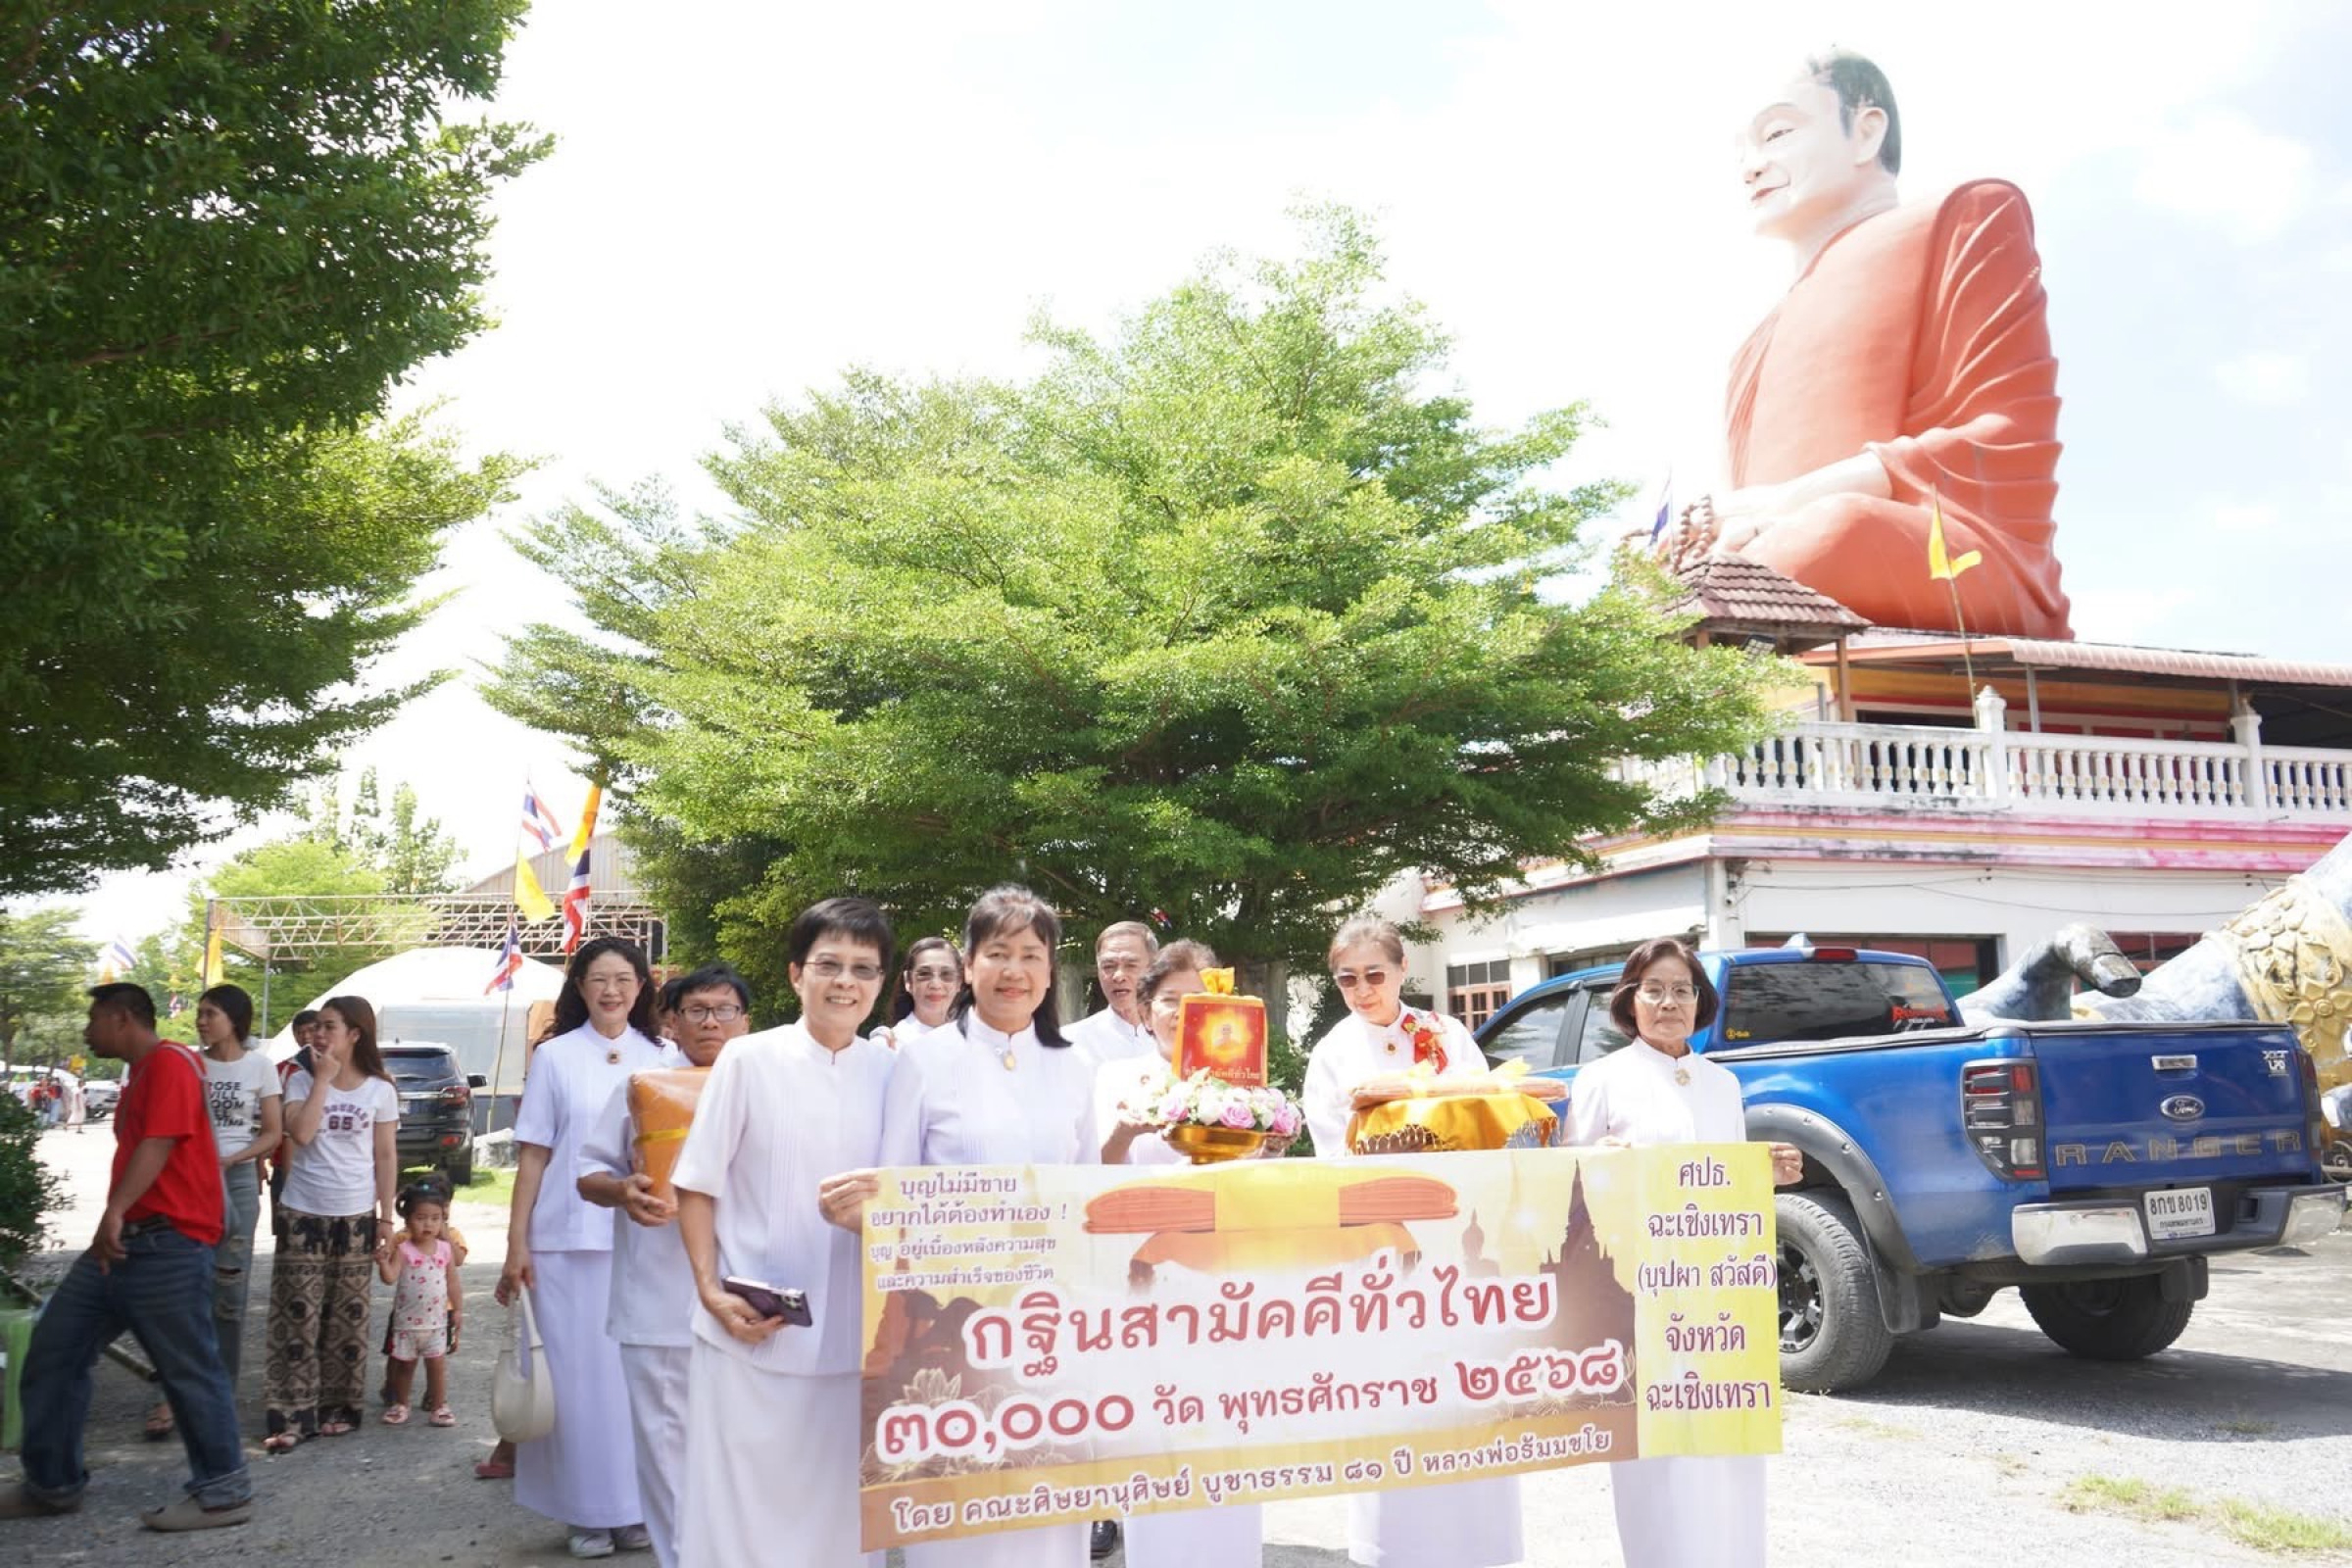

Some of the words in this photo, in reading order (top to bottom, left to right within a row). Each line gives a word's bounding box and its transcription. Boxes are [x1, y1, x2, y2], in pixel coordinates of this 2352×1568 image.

[328, 1114, 354, 1130] 65
[2054, 1130, 2301, 1166] RANGER
[901, 1171, 1017, 1200] บุญไม่มีขาย
[1680, 1156, 1731, 1187] ศปธ.
[871, 1200, 1052, 1227] อยากได้ต้องทำเอง
[1648, 1203, 1763, 1237] ฉะเชิงเทรา
[2178, 1193, 2208, 1212] 8019
[1638, 1258, 1700, 1297] (บุปผา
[1709, 1254, 1777, 1288] สวัสดี)
[971, 1255, 1550, 1377] กฐินสามัคคีทั่วไทย
[1665, 1312, 1745, 1351] จังหวัด
[884, 1395, 1135, 1454] ๓๐,๐๐๐
[1152, 1384, 1203, 1425] วัด
[1218, 1372, 1439, 1434] พุทธศักราช
[1454, 1346, 1618, 1399] ๒๕๖๘
[1646, 1371, 1771, 1411] ฉะเชิงเทรา
[894, 1500, 952, 1530] โดย
[965, 1467, 1190, 1520] คณะศิษยานุศิษย์
[1202, 1465, 1333, 1502] บูชาธรรม
[1345, 1461, 1383, 1480] ๘๑
[1394, 1448, 1412, 1475] ปี
[1423, 1426, 1611, 1473] หลวงพ่อธัมมชโย
